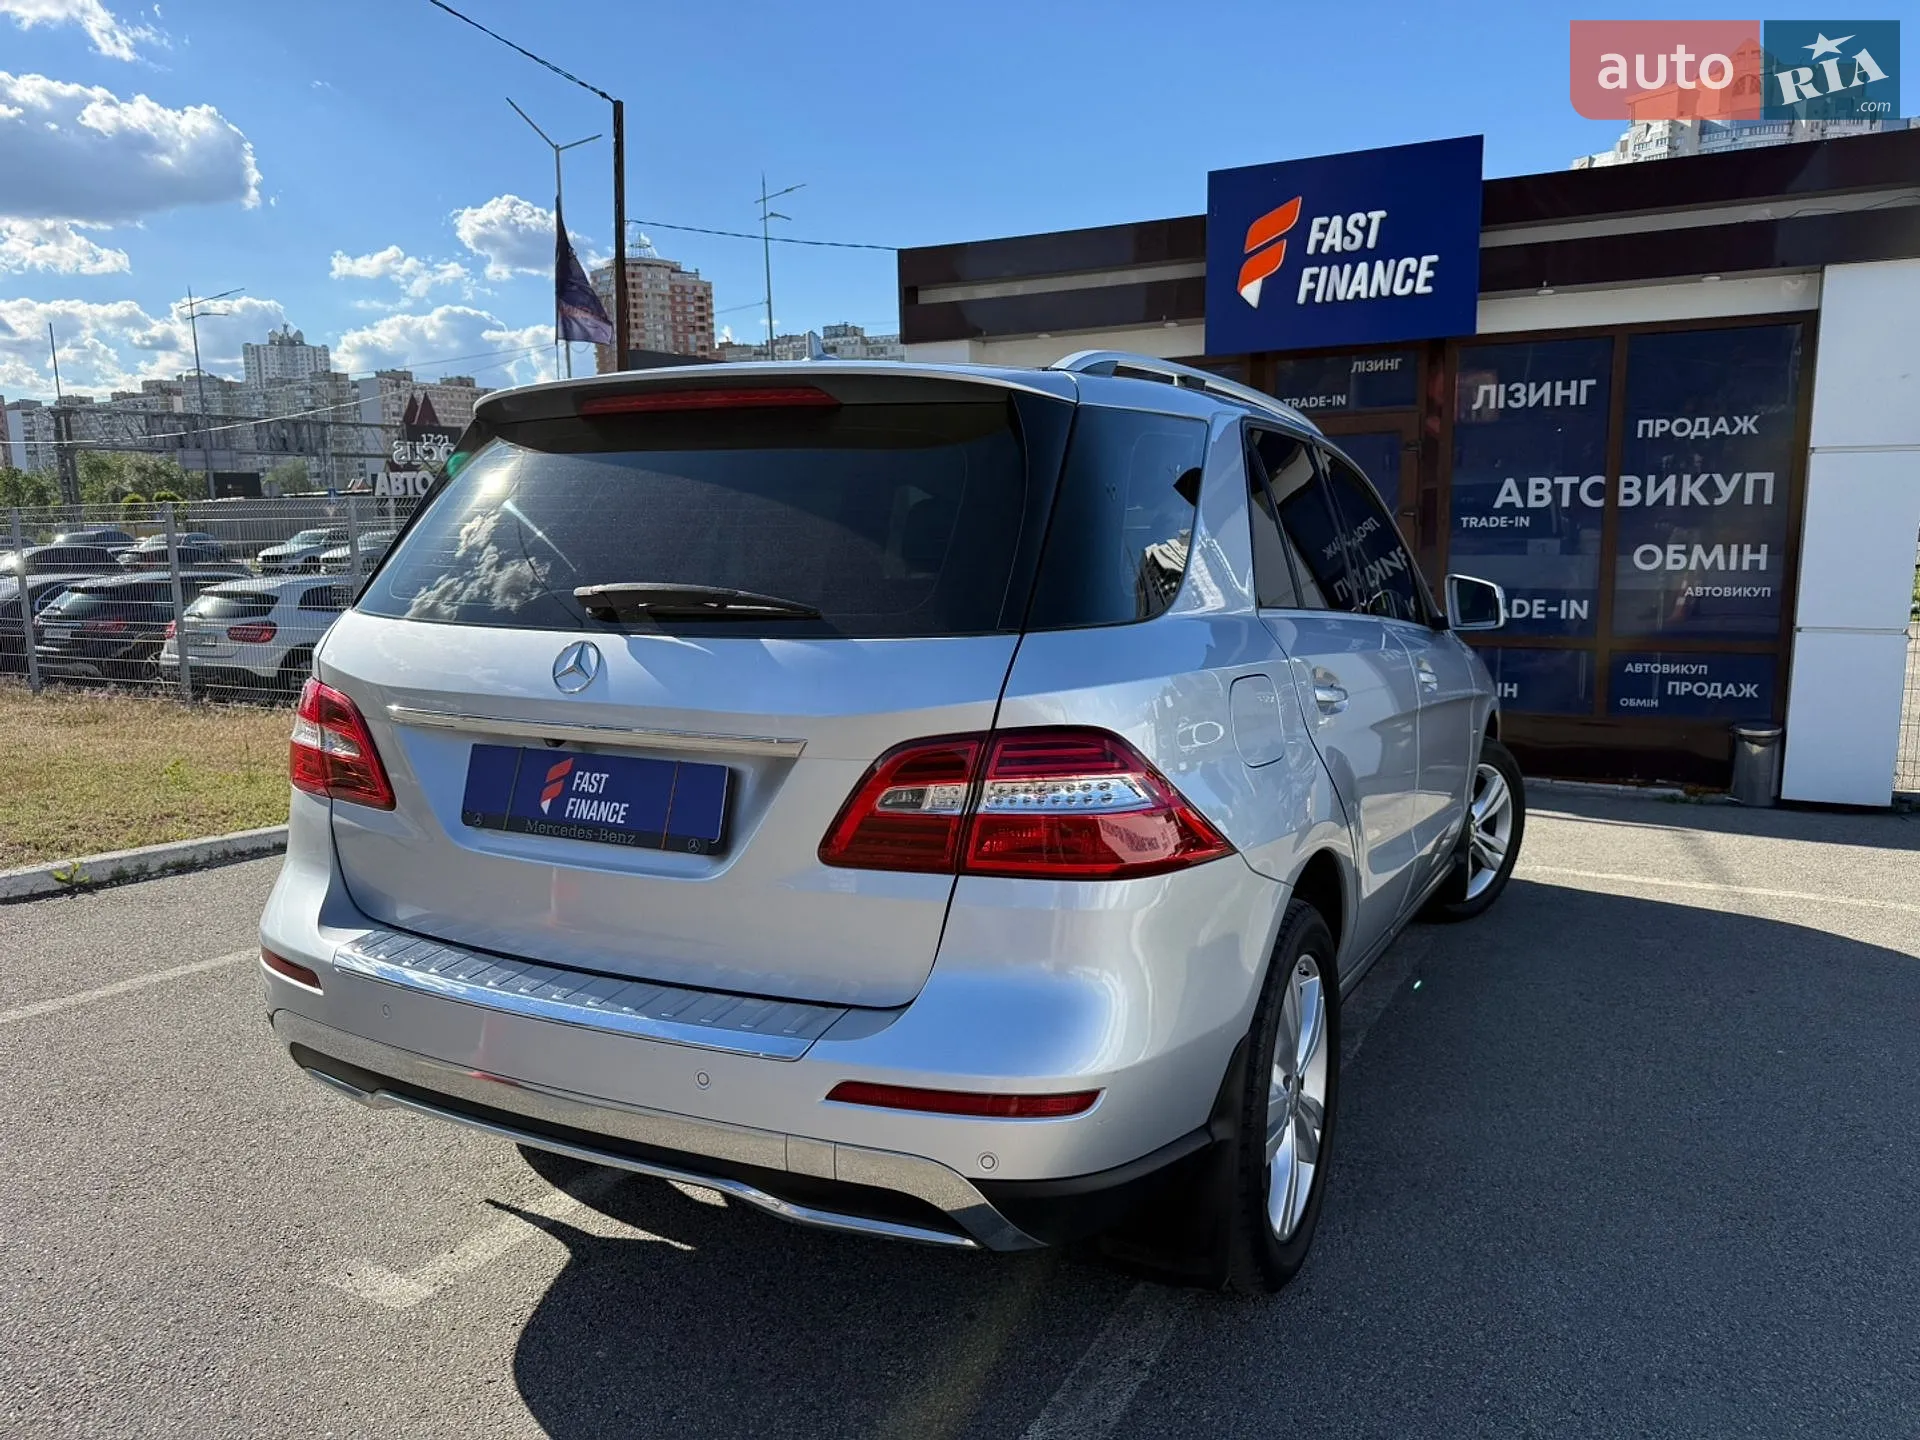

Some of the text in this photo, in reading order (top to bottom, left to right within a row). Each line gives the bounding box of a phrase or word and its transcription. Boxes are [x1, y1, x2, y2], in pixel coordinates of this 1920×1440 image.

[1306, 210, 1388, 255] FAST
[1297, 254, 1440, 305] FINANCE
[1351, 358, 1403, 374] ЛІЗИНГ
[1283, 394, 1347, 409] TRADE-IN
[1472, 379, 1597, 411] ЛІЗИНГ
[1636, 414, 1760, 440] ПРОДАЖ
[1460, 515, 1531, 529] TRADE-IN
[1632, 544, 1769, 571] ОБМІН
[1684, 585, 1772, 598] АВТОВИКУП
[1504, 598, 1590, 620] DE-IN
[1624, 662, 1709, 676] АВТОВИКУП
[1666, 681, 1760, 699] ПРОДАЖ
[1619, 697, 1659, 708] ОБМІН
[571, 770, 610, 795] FAST
[564, 798, 630, 825] FINANCE
[525, 818, 637, 846] Mercedes-Benz
